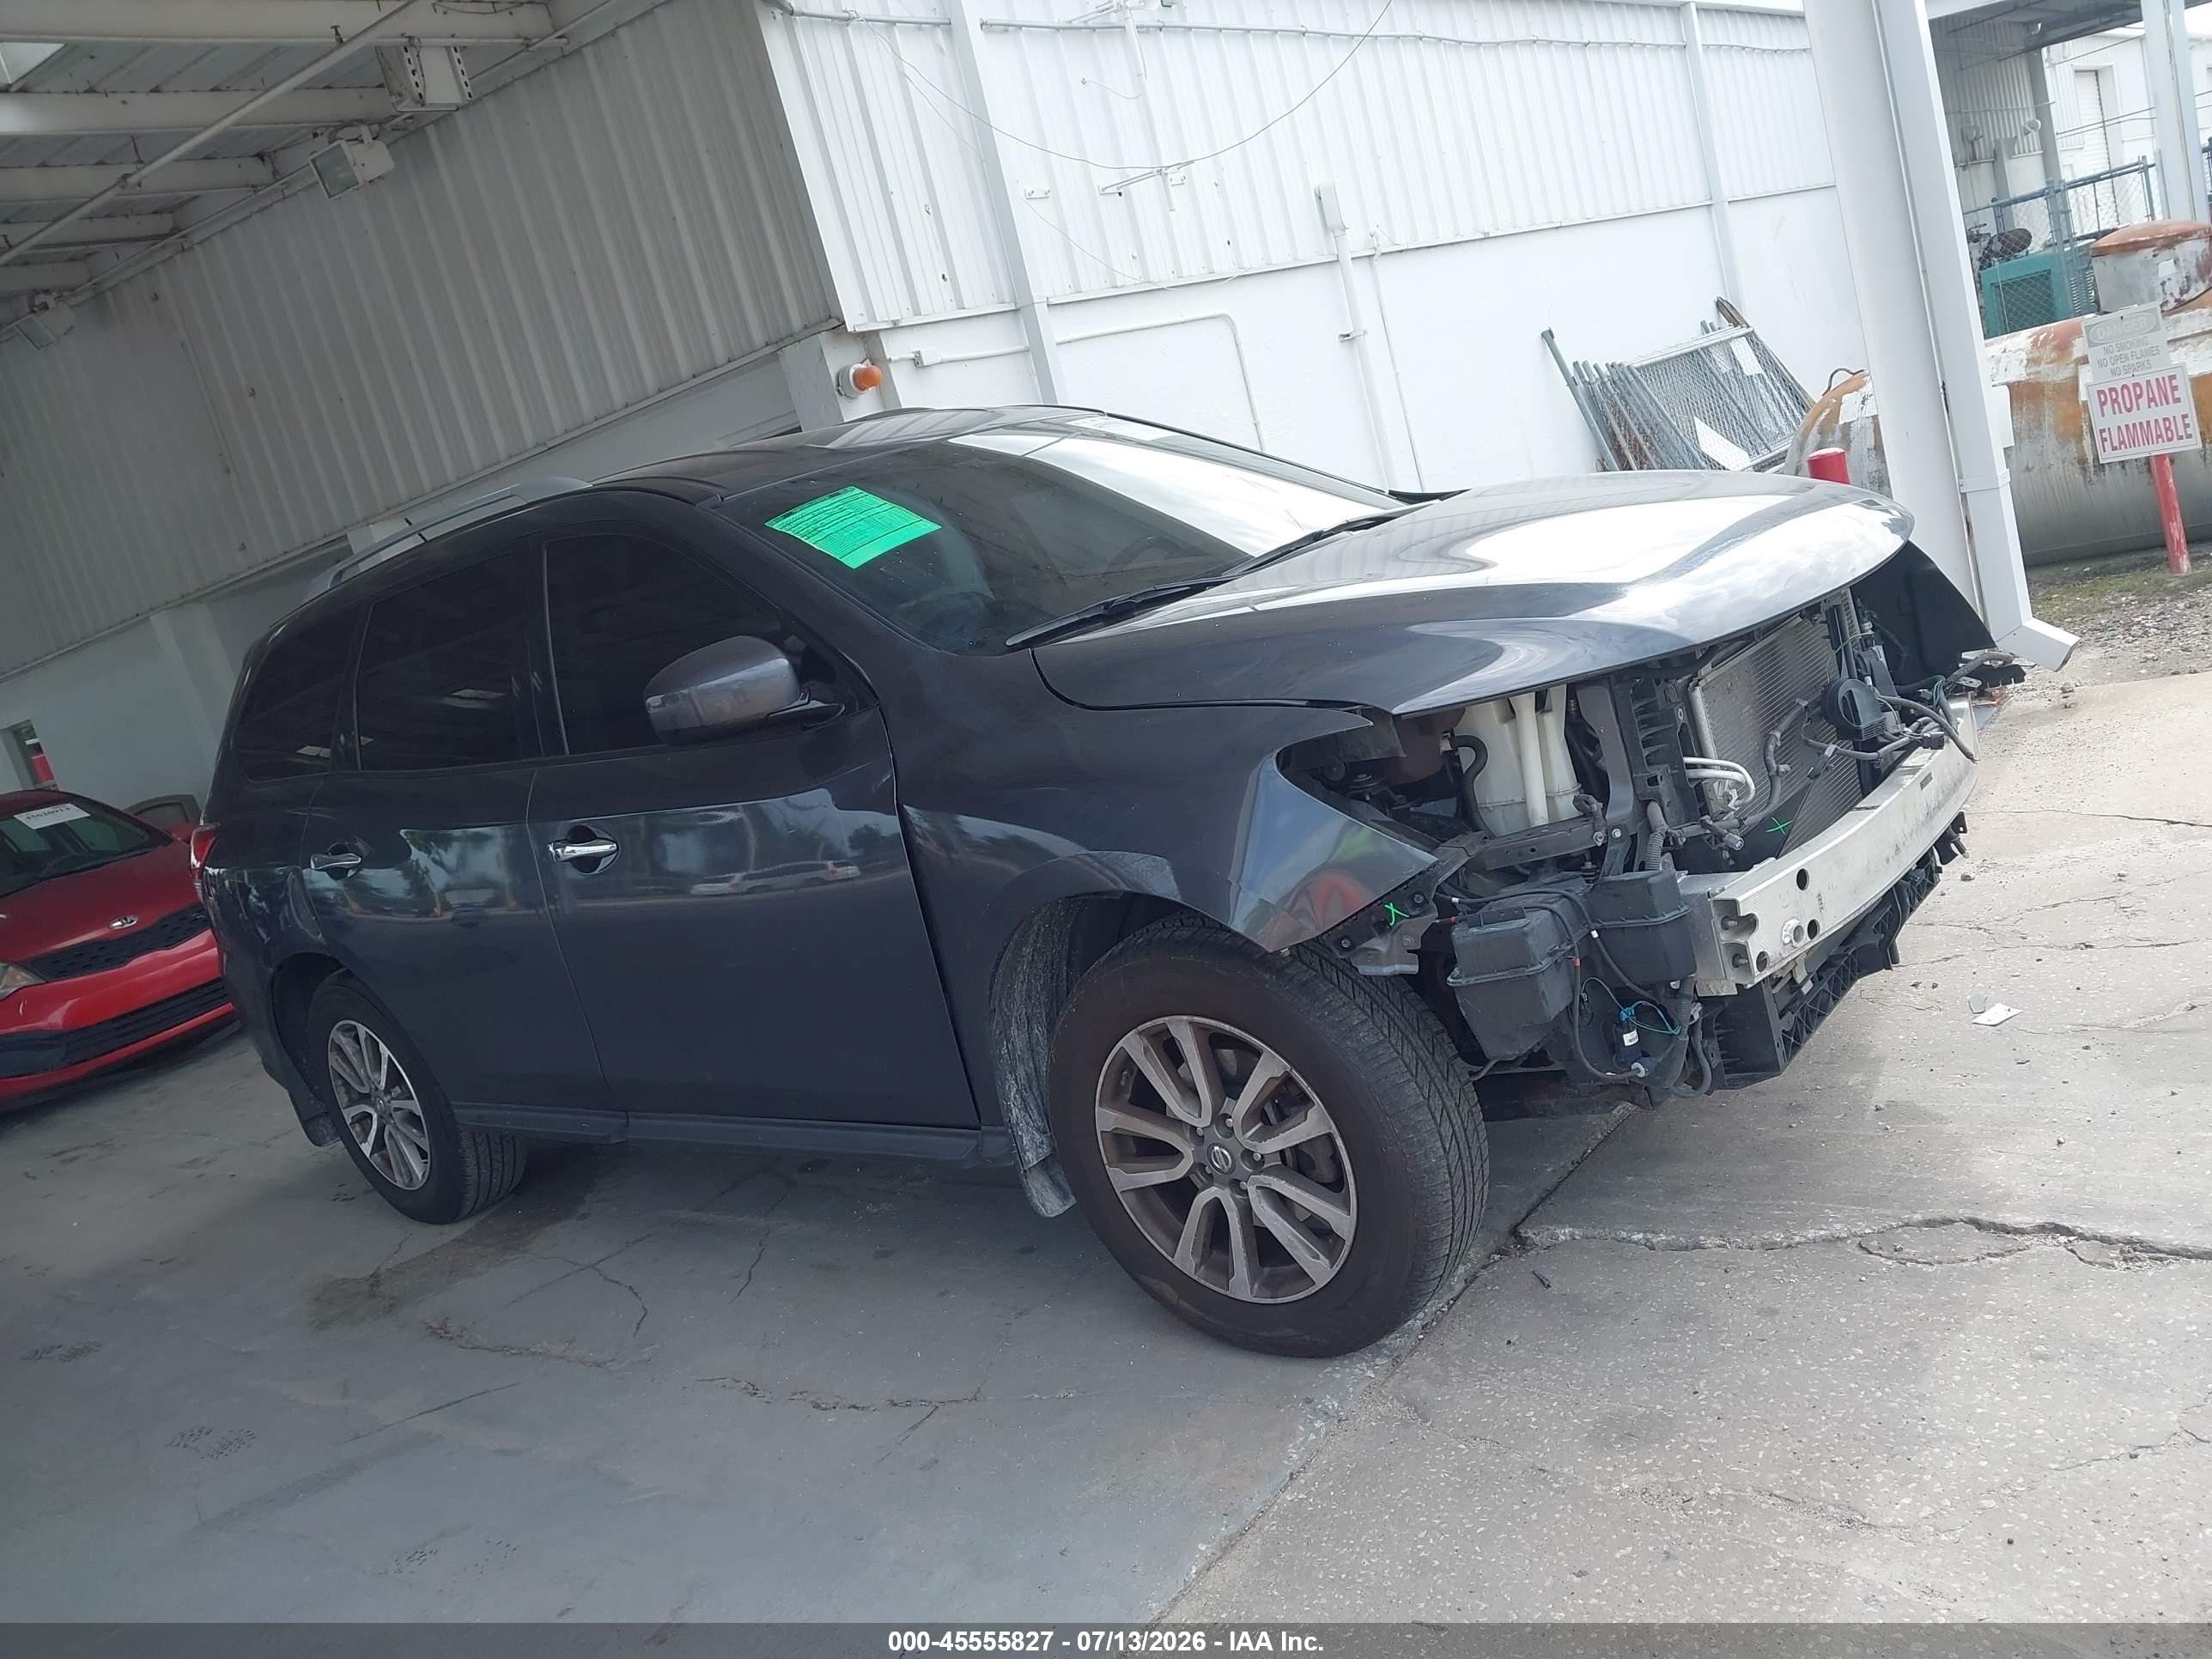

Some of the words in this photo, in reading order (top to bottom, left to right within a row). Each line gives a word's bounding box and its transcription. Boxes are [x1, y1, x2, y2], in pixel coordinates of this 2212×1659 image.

[2096, 316, 2148, 339] DANGER
[2097, 358, 2108, 369] NO
[2109, 352, 2130, 366] OPEN
[2130, 345, 2160, 360] FLAMES
[2103, 344, 2114, 356] NO
[2110, 366, 2122, 377] NO
[2123, 359, 2152, 374] SPARKS
[2096, 374, 2182, 417] PROPANE
[2099, 414, 2193, 453] FLAMMABLE
